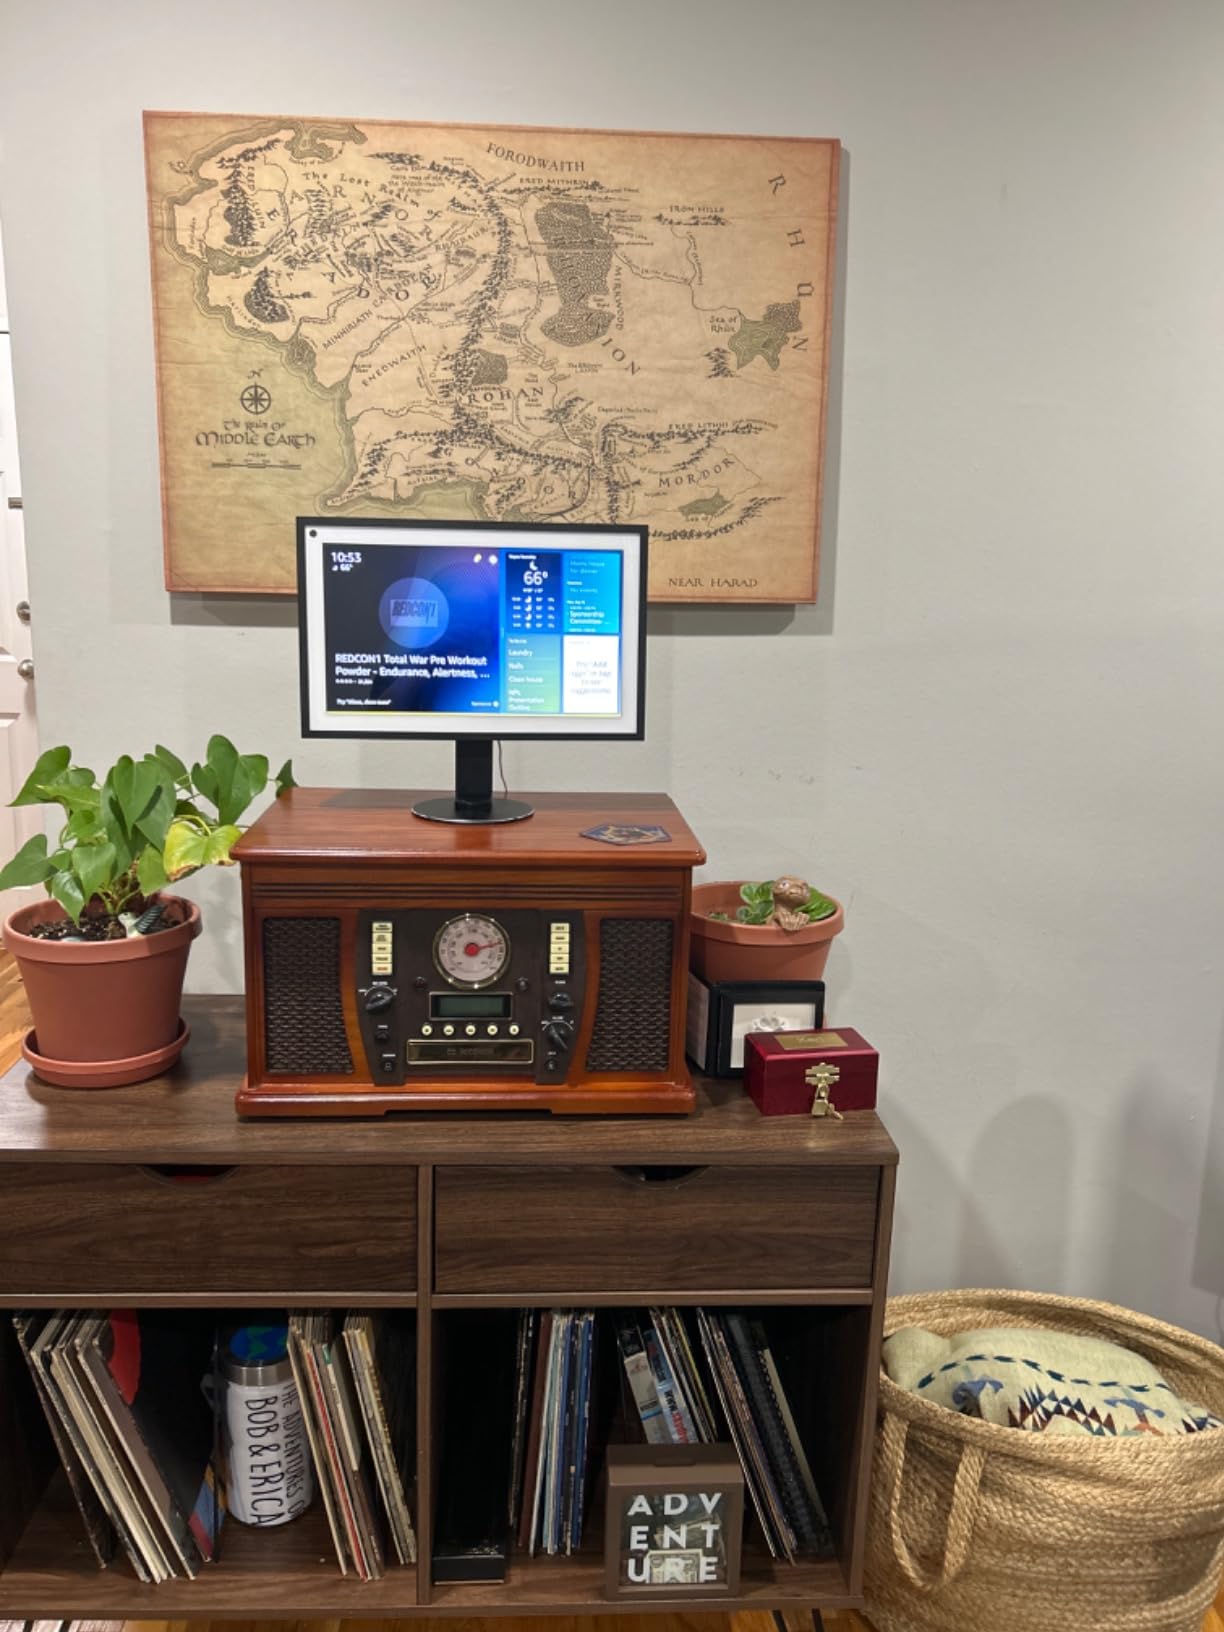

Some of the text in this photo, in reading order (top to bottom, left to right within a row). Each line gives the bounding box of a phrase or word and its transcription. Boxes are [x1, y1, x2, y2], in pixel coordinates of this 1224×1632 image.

[486, 142, 585, 172] FORODWAITH
[303, 171, 443, 221] The Lost Realm of
[670, 205, 695, 213] IRON
[709, 315, 737, 324] Sea of
[468, 387, 544, 404] ROHAN
[659, 457, 736, 489] MORDOR
[331, 552, 362, 564] 10:53
[523, 571, 549, 586] 66°
[668, 577, 759, 588] NEAR HARAD
[335, 653, 489, 666] REDCON1 Total War Pre Workout
[335, 666, 372, 676] Powder
[379, 666, 431, 679] Endurance,
[432, 667, 478, 679] Alertness,
[246, 1395, 286, 1525] BOB & ERICA
